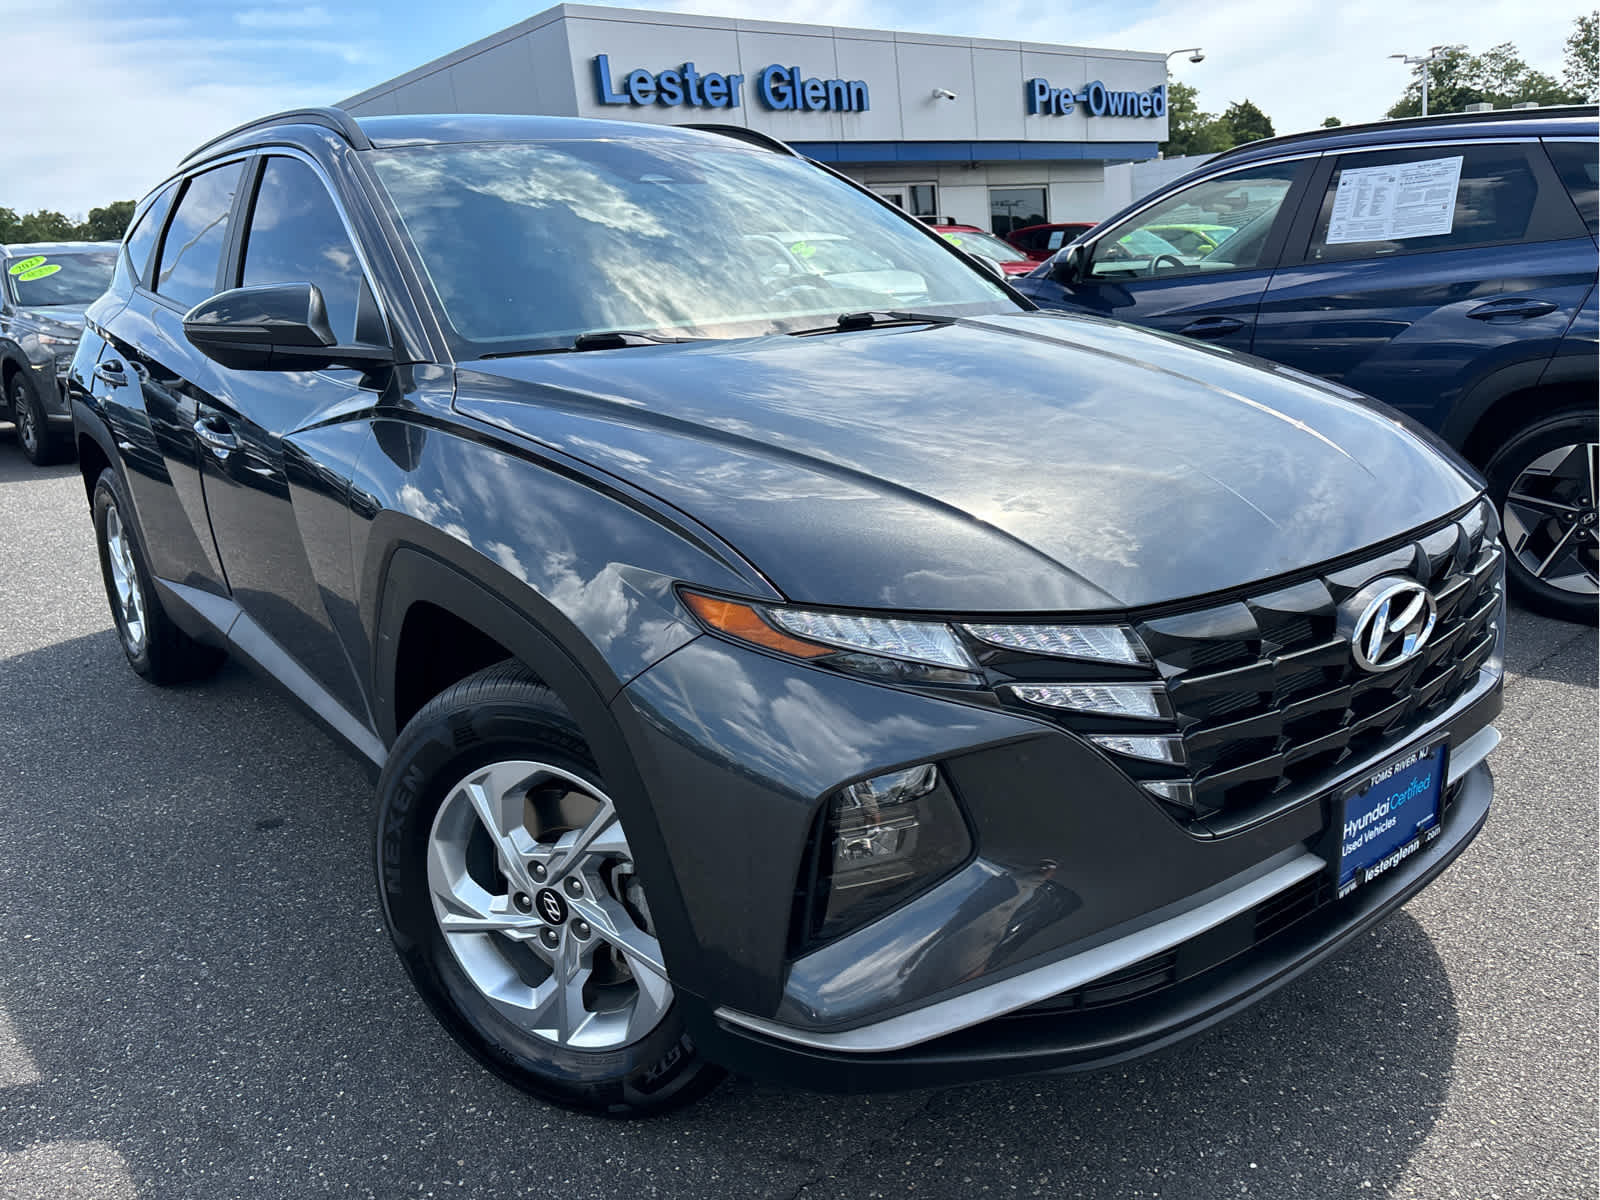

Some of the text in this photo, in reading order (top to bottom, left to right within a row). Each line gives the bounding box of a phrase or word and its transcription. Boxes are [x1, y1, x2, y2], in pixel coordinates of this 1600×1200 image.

[593, 54, 870, 113] Lester Glenn
[1028, 78, 1166, 117] Pre-Owned
[1371, 767, 1393, 787] TOMS
[1419, 746, 1429, 760] NJ
[1343, 772, 1431, 840] Hyundai Certified
[386, 764, 424, 896] NEXEN
[1342, 816, 1397, 857] Used Vehicles
[1364, 840, 1420, 883] lesterglenn
